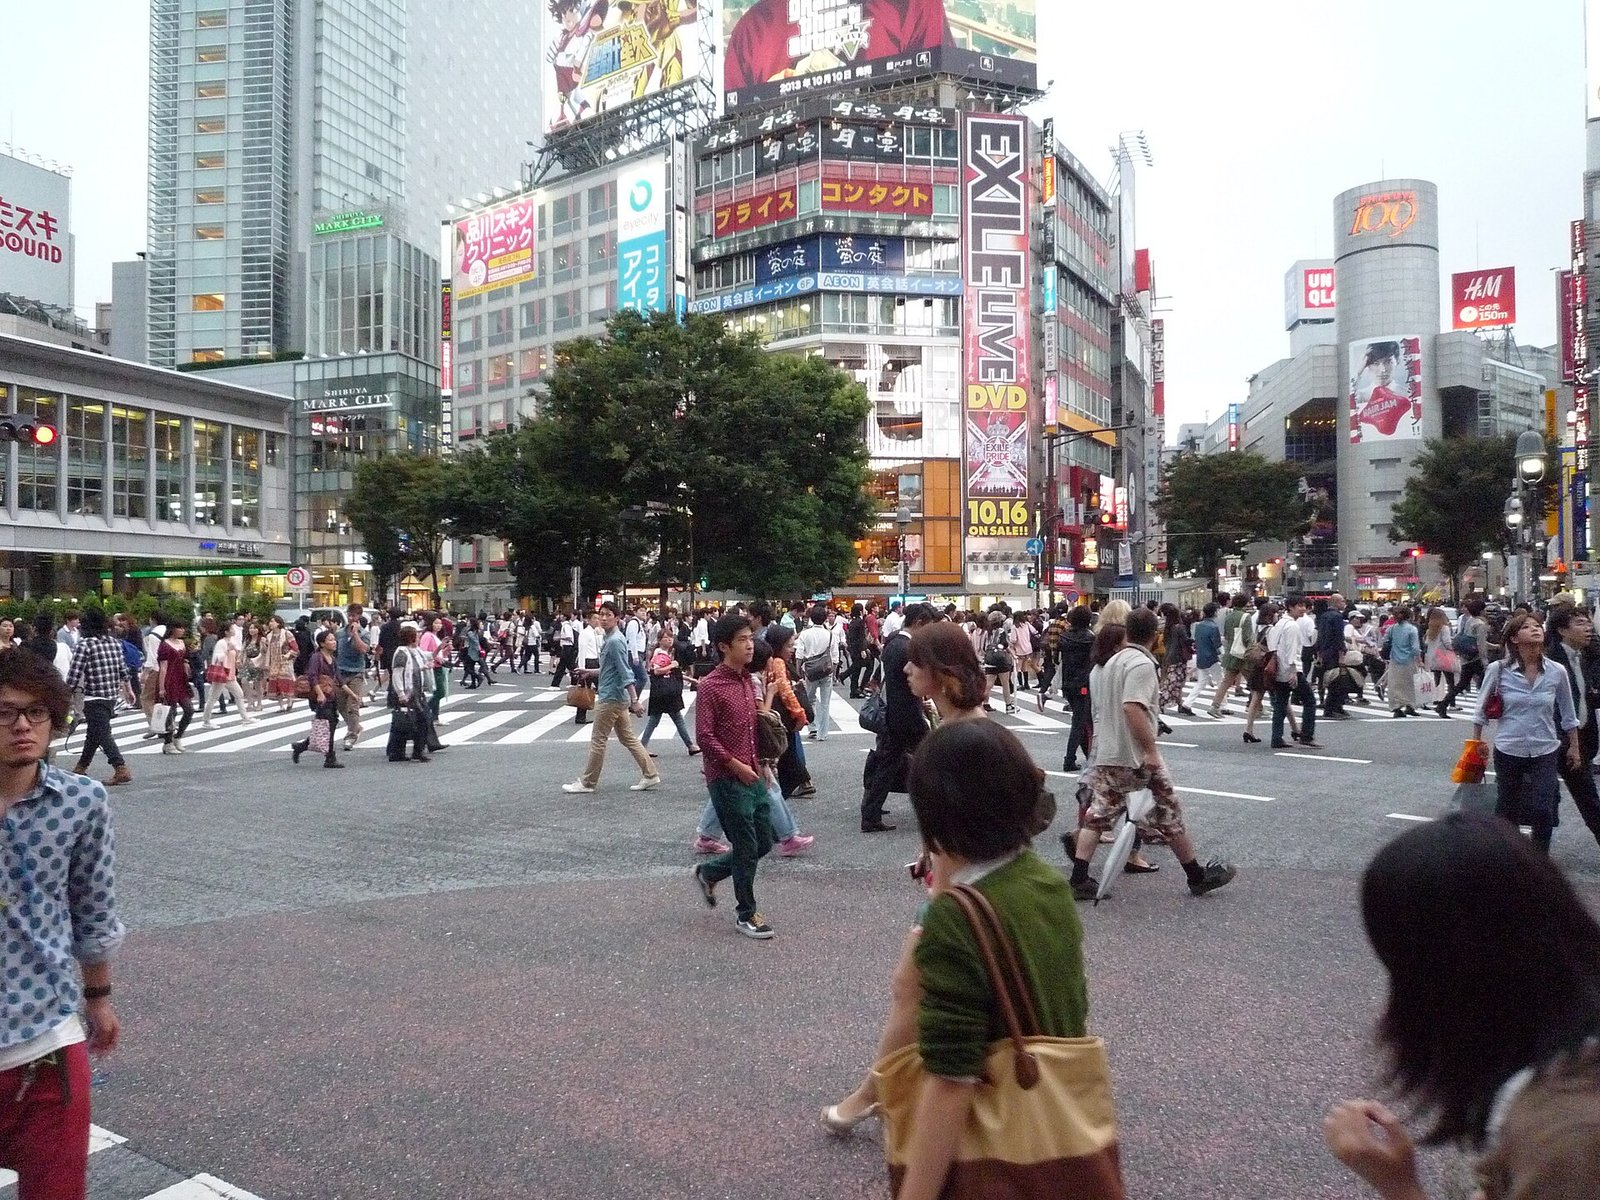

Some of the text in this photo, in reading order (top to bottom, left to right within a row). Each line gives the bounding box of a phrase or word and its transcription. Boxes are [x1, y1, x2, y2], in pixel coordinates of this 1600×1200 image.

[822, 183, 929, 208] コンタクト
[967, 117, 1024, 288] EXILE
[716, 190, 795, 230] プライス
[1347, 200, 1417, 238] 109
[315, 215, 382, 232] MARK CITY
[466, 205, 533, 244] 品川スキン
[0, 229, 62, 264] OUND
[467, 226, 532, 264] クリニック
[824, 275, 860, 288] AEON
[866, 275, 960, 292] 英会話イーオン
[1464, 275, 1502, 301] H&M
[692, 299, 718, 313] AEON
[722, 282, 795, 308] 英会話イーオン
[1479, 311, 1508, 321] 150m
[978, 289, 1017, 383] LIVE
[303, 393, 393, 410] MARK CITY
[324, 387, 368, 397] SHIBUYA
[967, 384, 1027, 409] DVD
[985, 452, 1010, 461] PRIDE
[968, 500, 1028, 525] 10.16
[968, 525, 1028, 536] ON SALE!!
